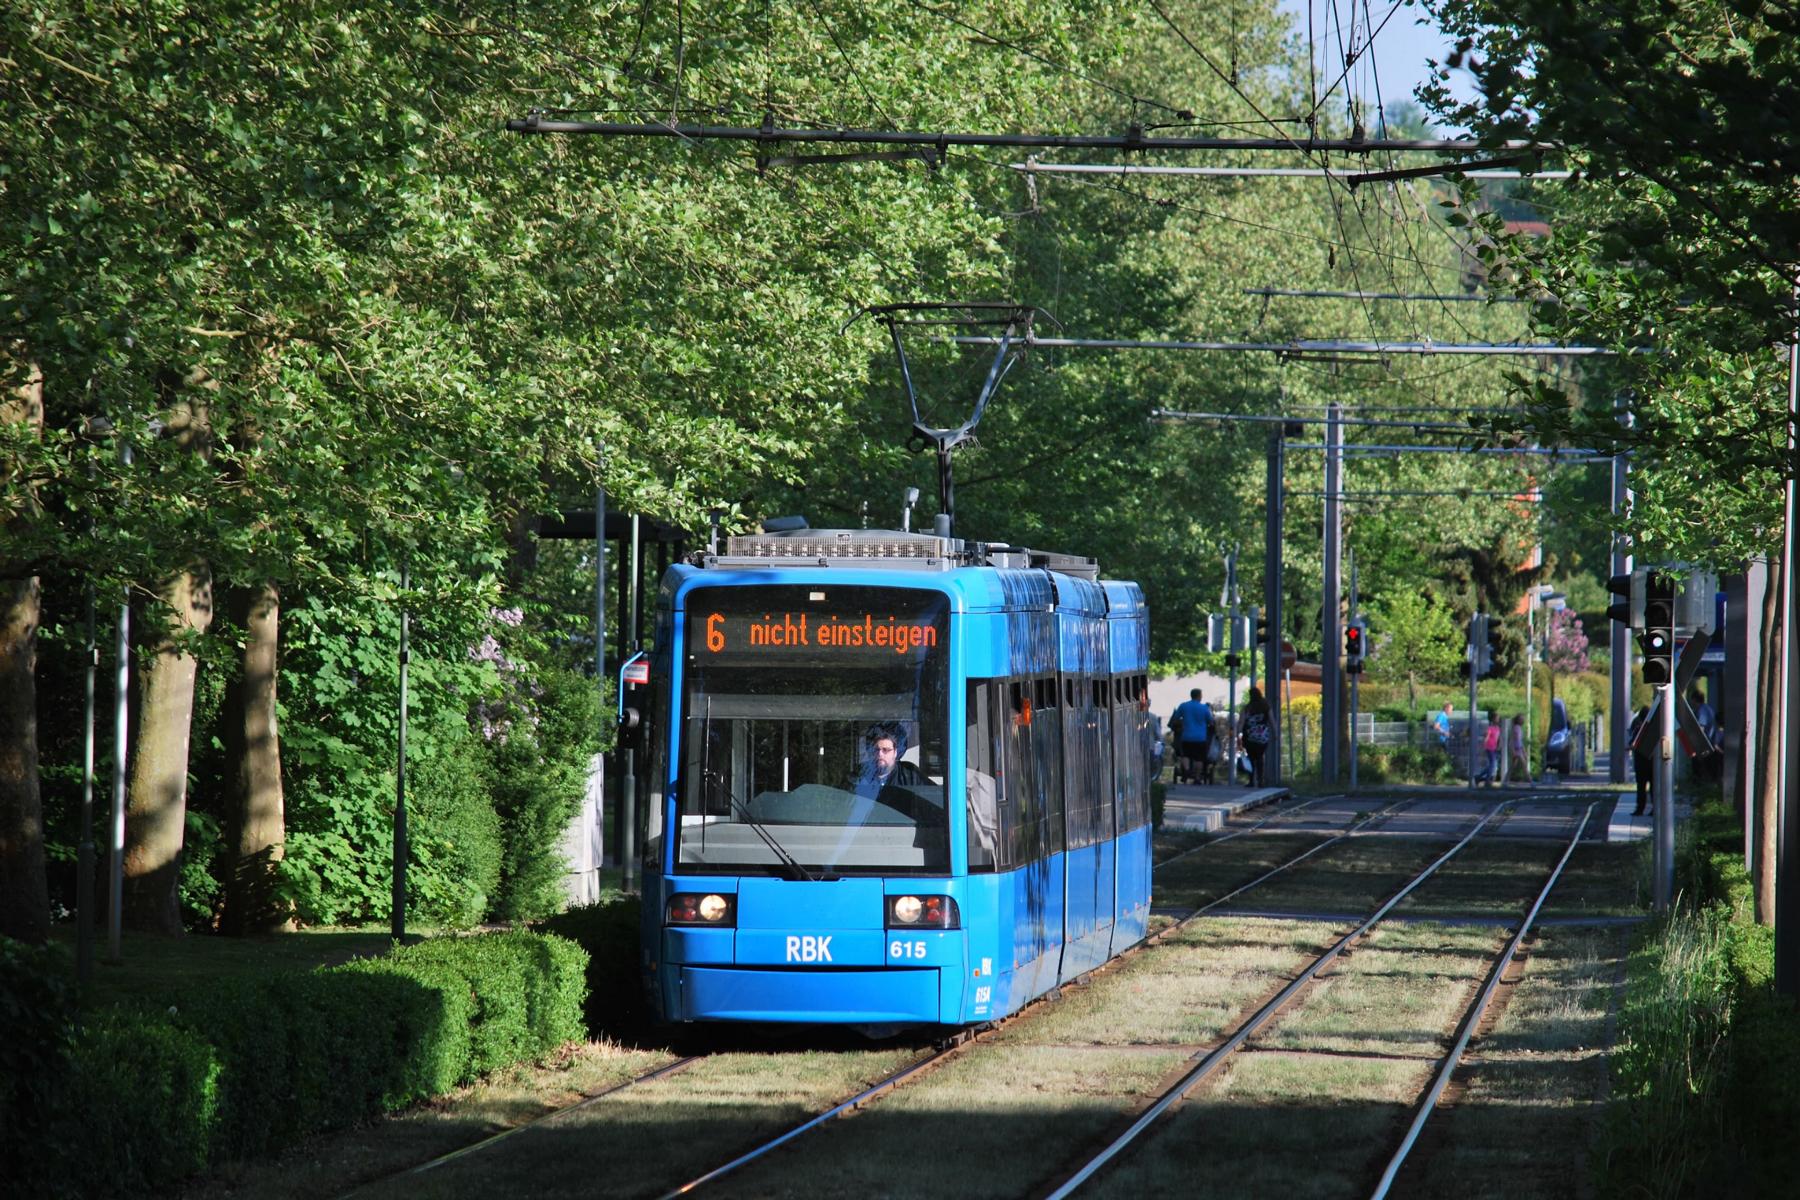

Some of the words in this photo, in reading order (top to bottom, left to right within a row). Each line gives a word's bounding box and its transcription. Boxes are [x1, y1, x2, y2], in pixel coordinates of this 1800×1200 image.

[706, 613, 726, 652] 6
[750, 613, 809, 646] nicht
[816, 614, 937, 654] einsteigen
[786, 935, 833, 962] RBK
[889, 941, 927, 959] 615
